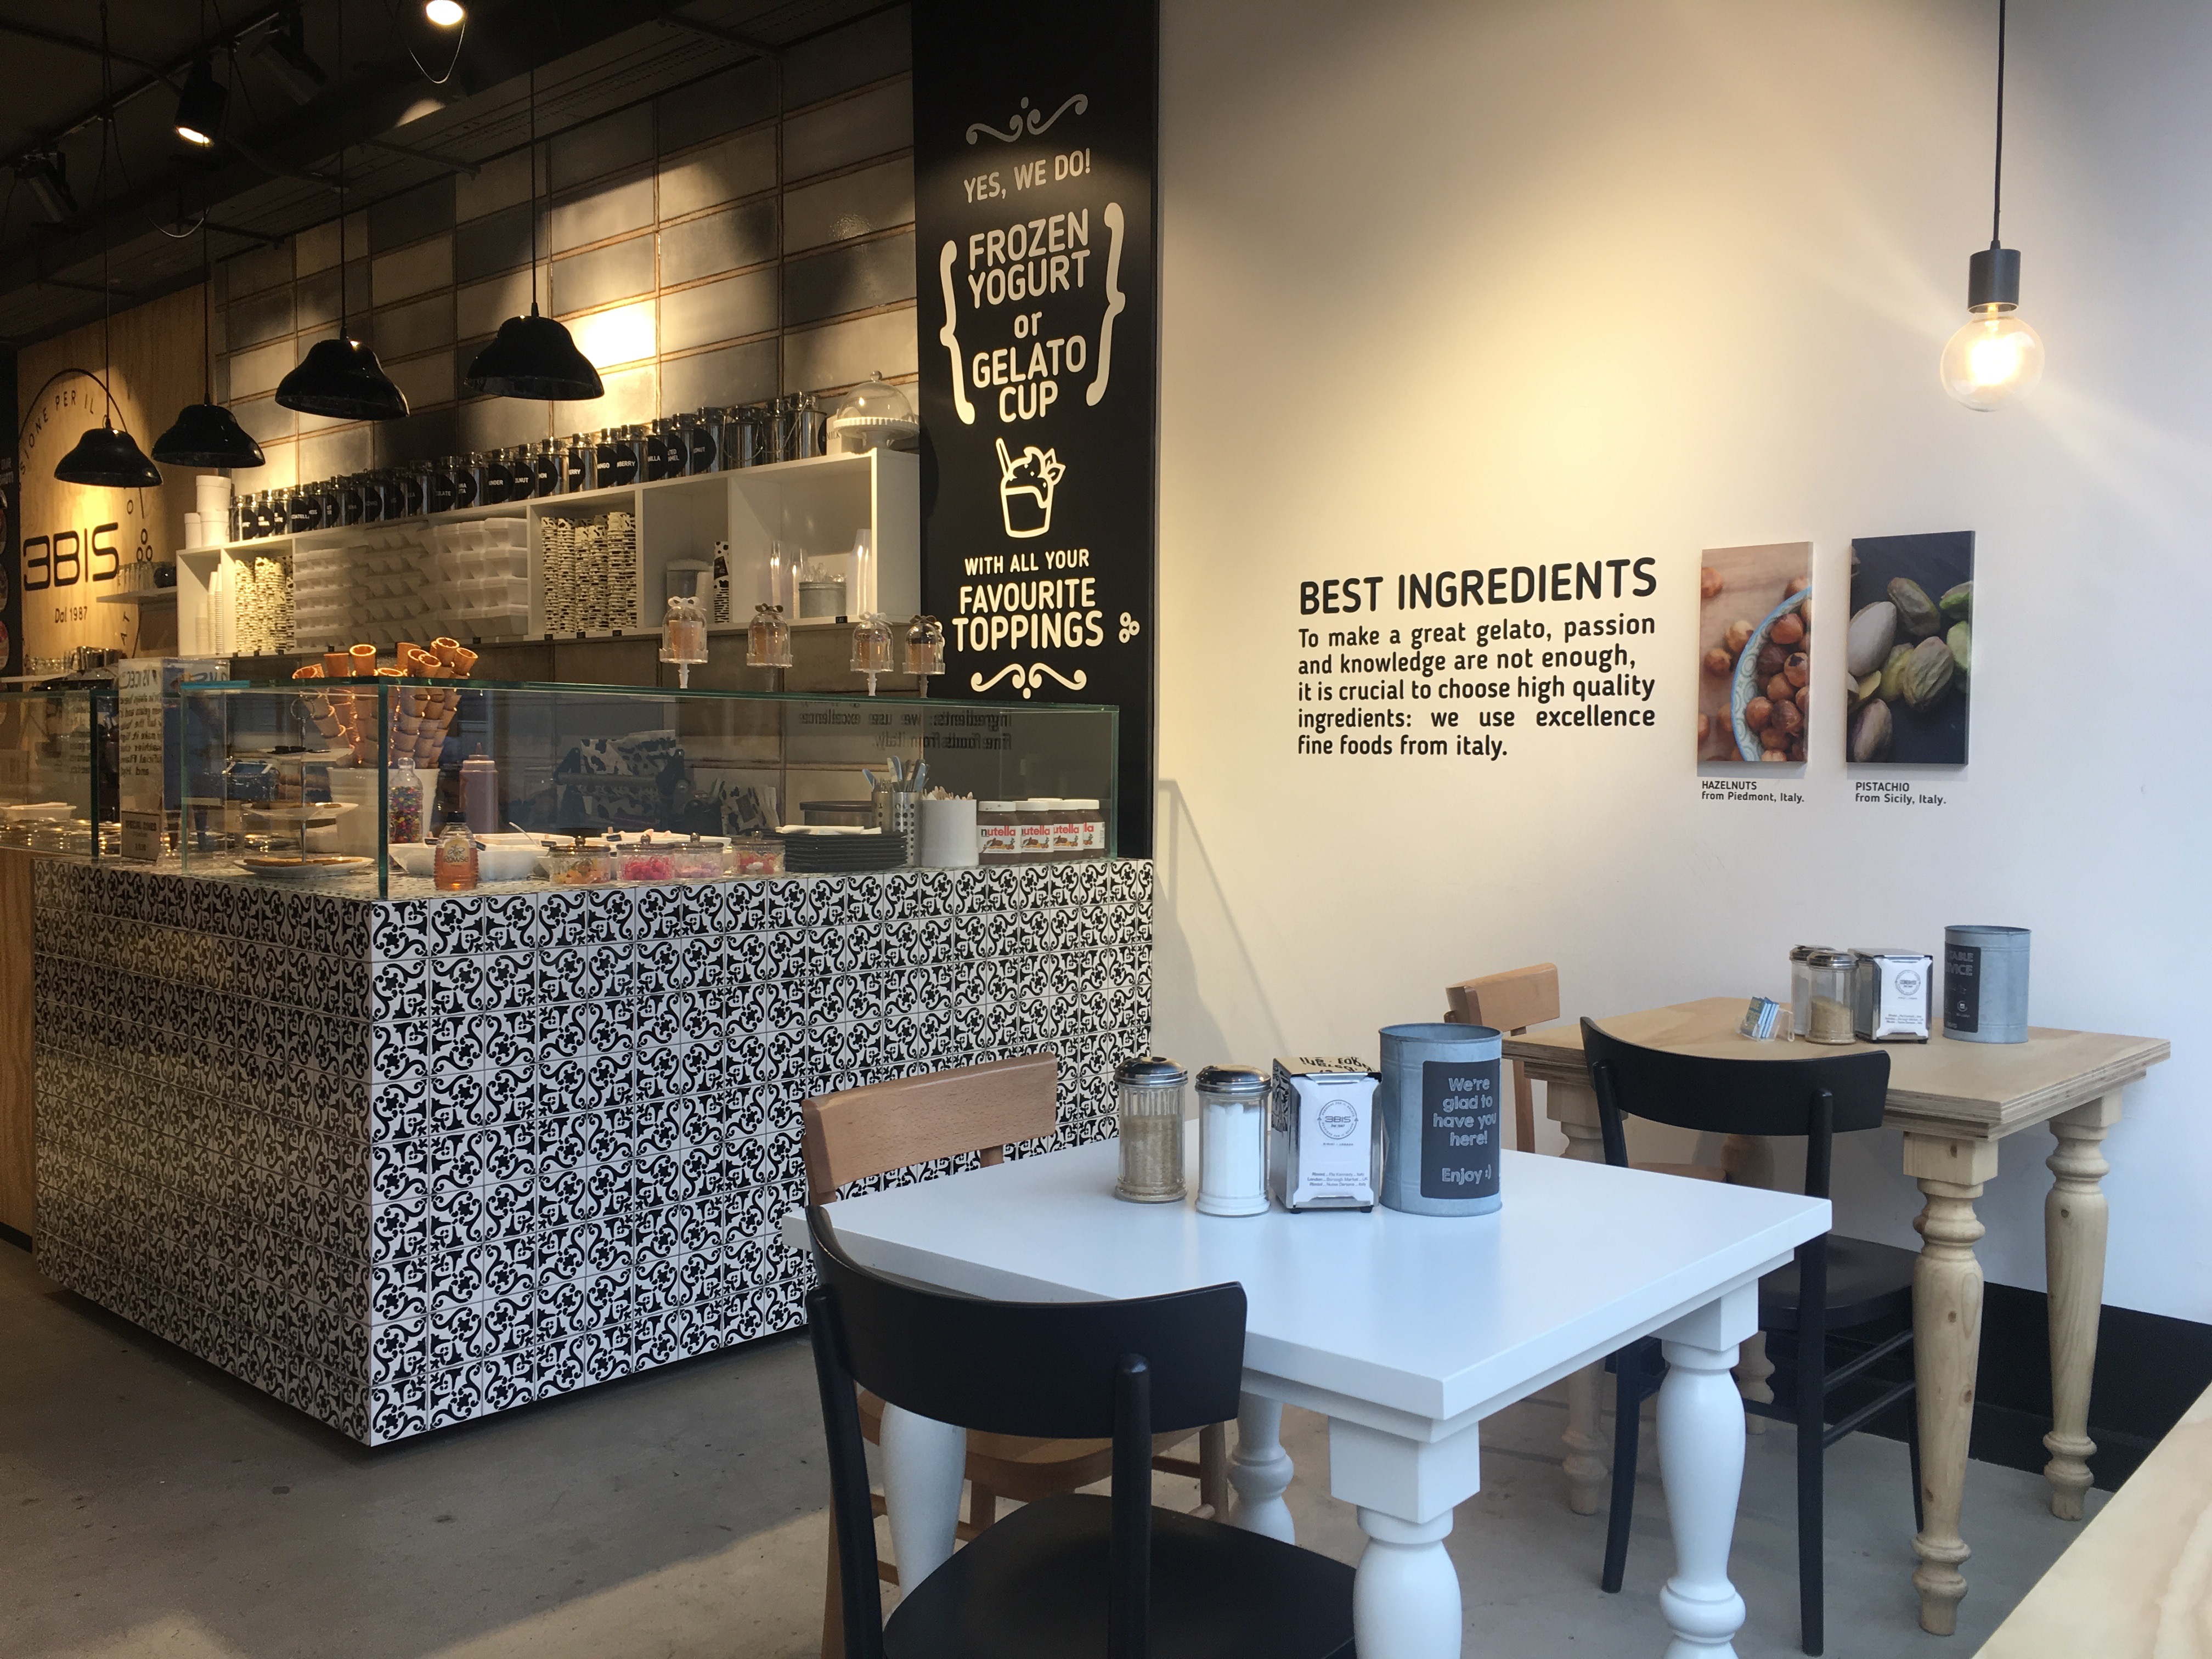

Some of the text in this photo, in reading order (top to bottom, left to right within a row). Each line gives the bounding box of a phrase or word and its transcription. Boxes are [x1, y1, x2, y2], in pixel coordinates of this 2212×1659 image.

[963, 148, 1091, 204] YES, WE DO!
[969, 208, 1088, 271] FROZEN
[967, 250, 1091, 309] YOGURT
[1014, 311, 1042, 338] or
[972, 335, 1087, 388] GELATO
[55, 390, 76, 411] PER
[84, 393, 94, 415] IL
[999, 380, 1059, 422] CUP
[23, 522, 120, 592] 3BIS
[964, 548, 1090, 576] WITH ALL YOUR
[960, 577, 1096, 614] FAVOURITE
[1300, 556, 1657, 615] BEST INGREDIENTS
[55, 605, 88, 624] Dal 1987
[952, 610, 1104, 652] TOPPINGS
[1298, 613, 1655, 650] To make a great gelato, passion
[1298, 644, 1636, 678] and knowledge are not enough,
[1298, 674, 1655, 704] it is crucial to choose high quality
[1298, 704, 1656, 734] ingredients: we use excellence
[1298, 735, 1508, 761] fine foods from italy.
[1701, 781, 1757, 790] HAZELNUTS
[1701, 791, 1805, 804] from Piedmont, Italy.
[1855, 781, 1910, 792] PISTACHIO
[1855, 793, 1946, 806] from Sicily, Italy.
[981, 825, 1016, 837] nutella
[1442, 1094, 1493, 1113] glad to
[1433, 1112, 1497, 1130] have you
[1449, 1131, 1488, 1147] here!
[1442, 1167, 1482, 1186] Enjoy
